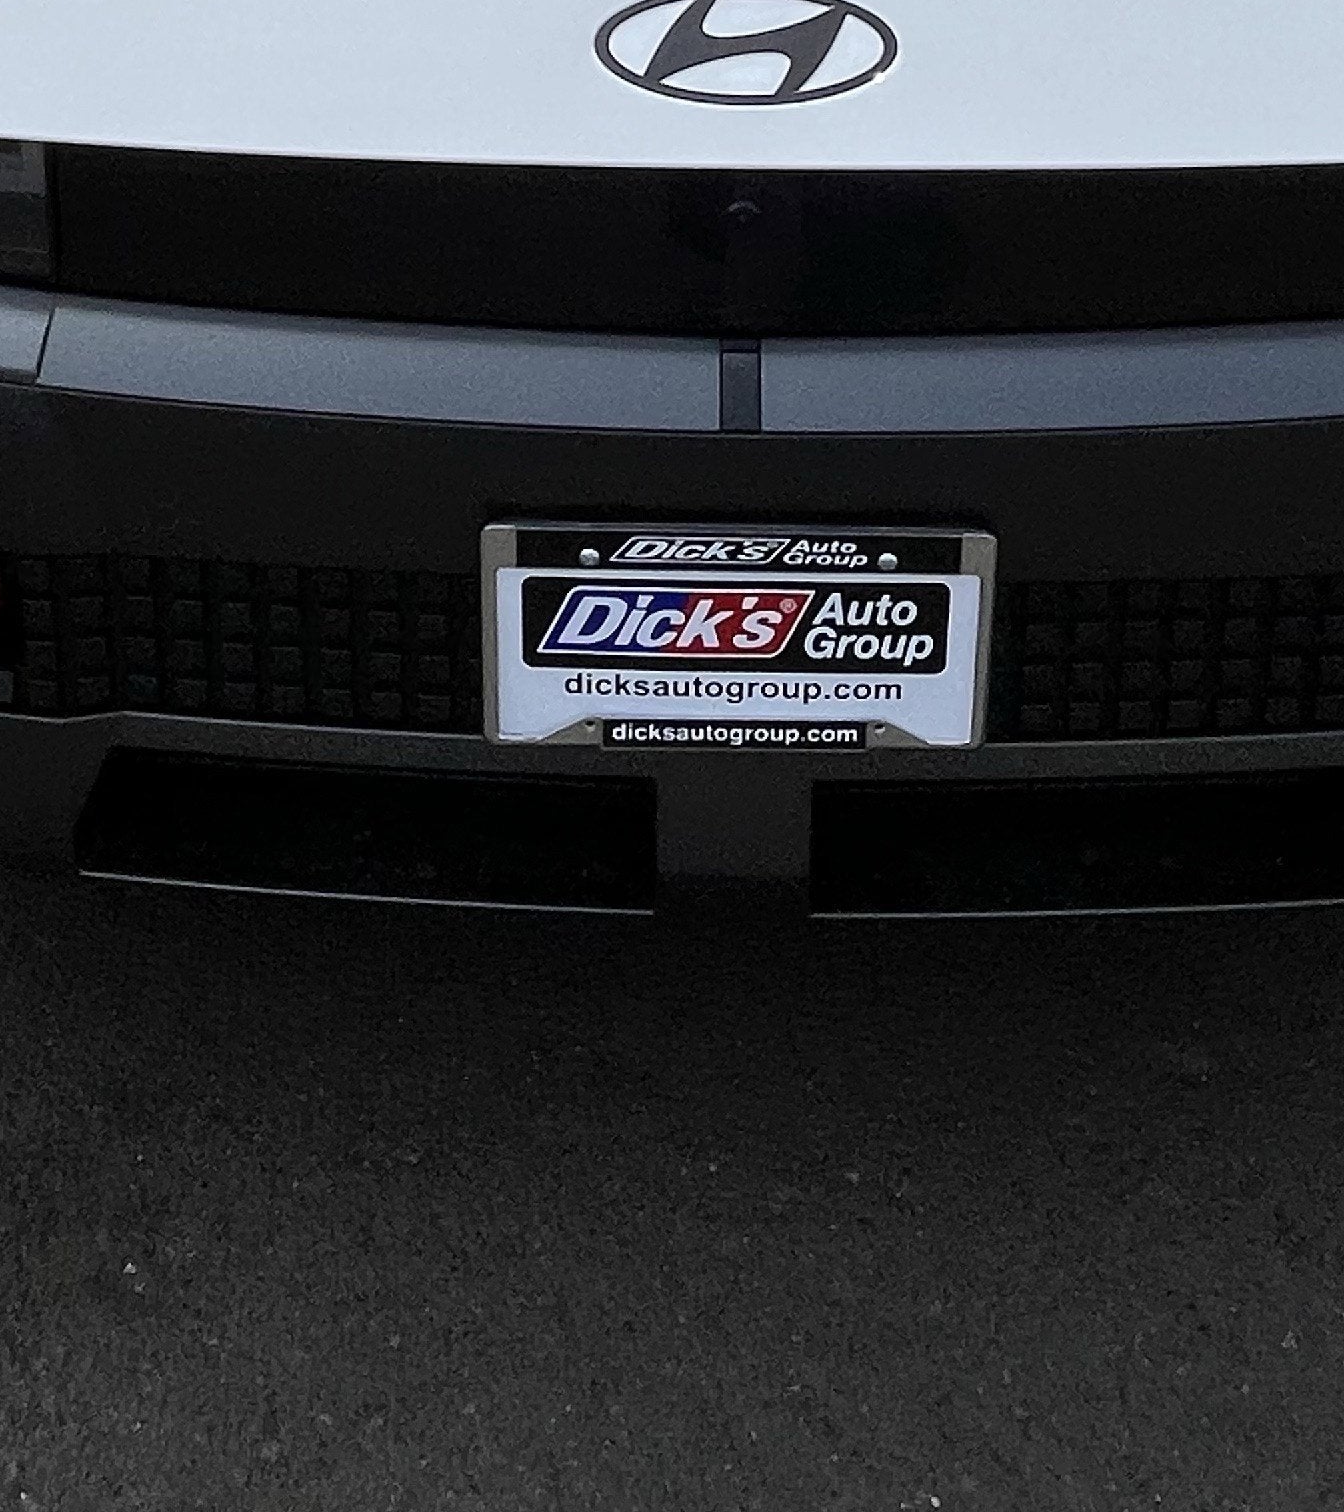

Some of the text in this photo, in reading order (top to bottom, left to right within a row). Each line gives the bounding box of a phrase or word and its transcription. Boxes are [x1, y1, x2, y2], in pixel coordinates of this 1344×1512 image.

[624, 539, 769, 561] Dick's
[782, 552, 868, 568] Group
[789, 539, 858, 554] Auto
[557, 594, 782, 650] Dick's
[812, 592, 918, 627] Auto
[804, 626, 934, 667] Group
[564, 672, 903, 704] dicksautogroup.com
[611, 723, 858, 746] dicksautogroup.com
